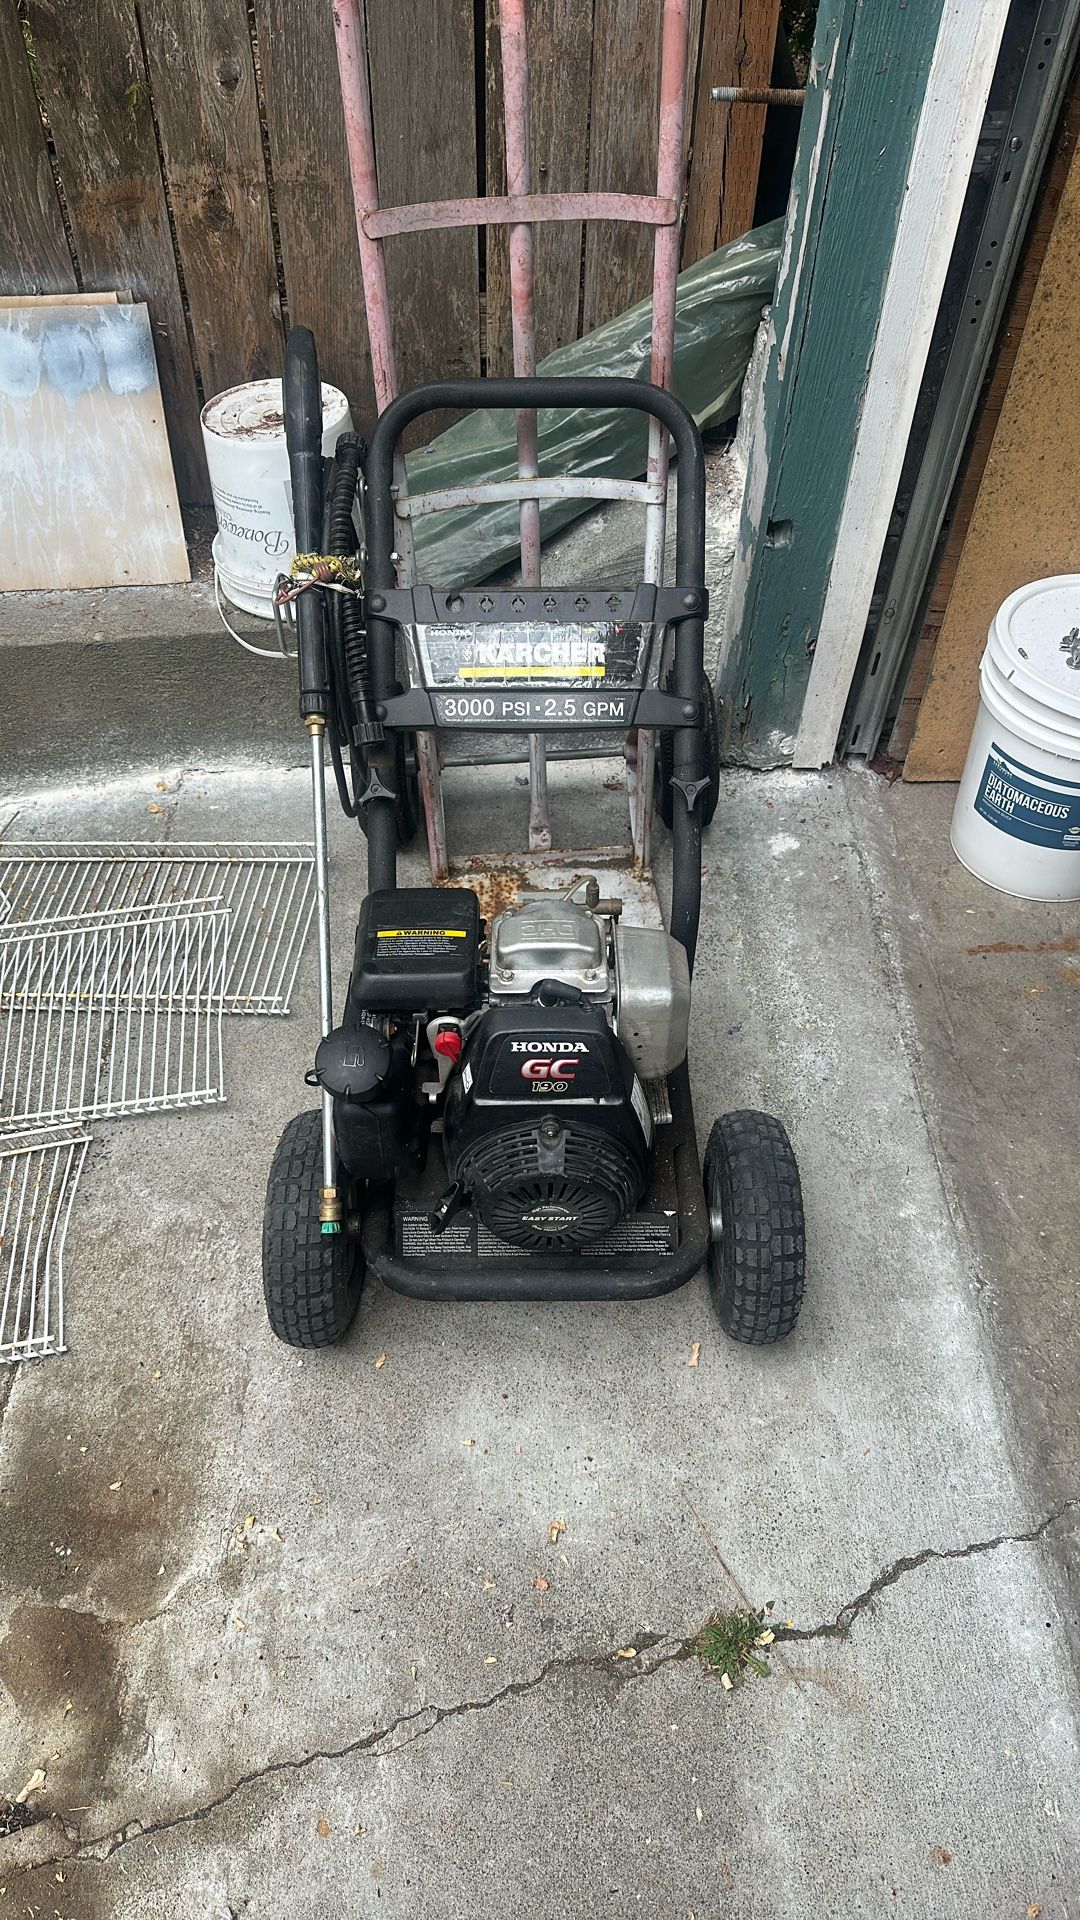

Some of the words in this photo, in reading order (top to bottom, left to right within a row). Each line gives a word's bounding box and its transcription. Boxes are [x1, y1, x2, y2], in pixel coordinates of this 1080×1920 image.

[430, 629, 473, 637] HONDA
[444, 698, 495, 716] 3000
[502, 702, 530, 716] PSI
[545, 698, 576, 716] 2.5
[583, 702, 624, 716] GPM
[984, 785, 1015, 814] EARTH
[987, 772, 1070, 819] DIATOMACEOUS
[510, 1042, 590, 1053] HONDA
[520, 1057, 580, 1079] GC
[531, 1081, 569, 1093] 190
